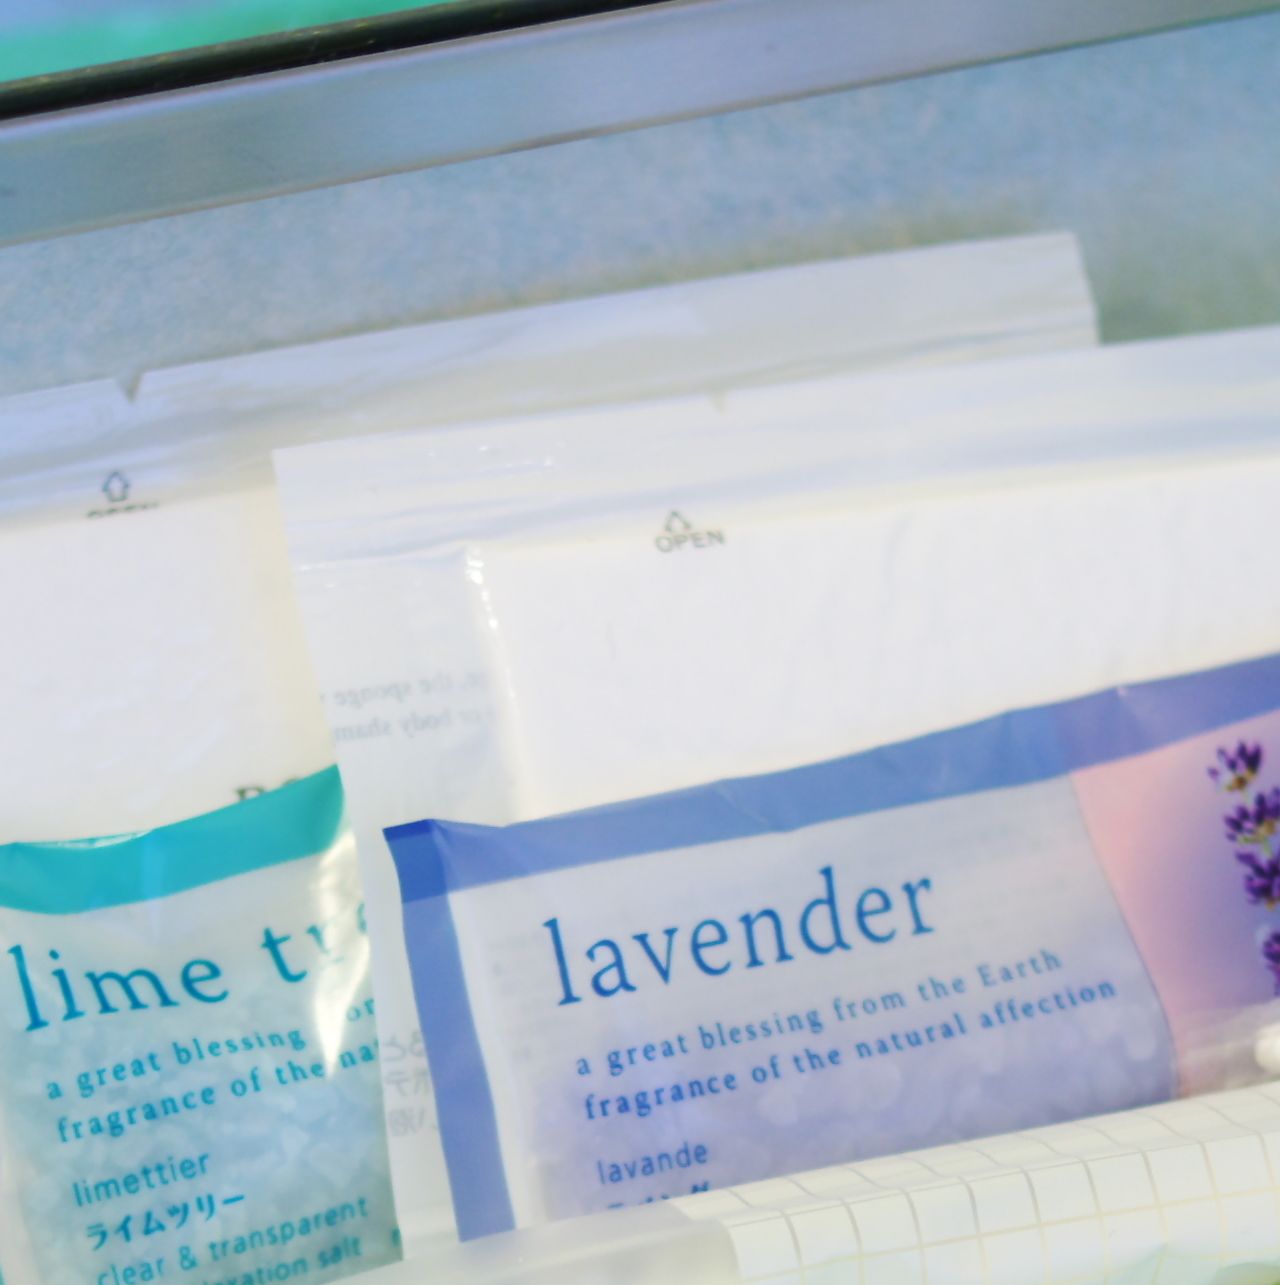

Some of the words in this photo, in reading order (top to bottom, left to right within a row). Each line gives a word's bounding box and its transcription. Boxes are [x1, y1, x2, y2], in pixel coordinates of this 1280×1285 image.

[654, 529, 726, 553] OPEN
[541, 864, 936, 1007] lavender
[8, 944, 230, 1033] lime
[576, 1053, 592, 1076] a
[606, 1033, 690, 1078] great
[698, 1004, 825, 1052] blessing
[832, 988, 908, 1024] from
[918, 970, 968, 1001] the
[977, 949, 1064, 989] Earth
[46, 1078, 63, 1101] a
[76, 1050, 162, 1099] great
[172, 1026, 307, 1068] blessing
[583, 1068, 739, 1121] fragrance
[751, 1055, 782, 1085] of
[793, 1041, 844, 1075] the
[854, 1012, 969, 1062] natural
[978, 978, 1118, 1031] affection
[56, 1085, 216, 1144] fragrance
[230, 1062, 263, 1098] of
[275, 1050, 326, 1086] the
[339, 1036, 379, 1069] na
[73, 1152, 213, 1208] limettier
[596, 1140, 708, 1185] lavande
[85, 1192, 246, 1250] ライムツリー
[178, 1244, 198, 1272] &
[208, 1195, 370, 1262] transparent
[316, 1233, 364, 1271] salt
